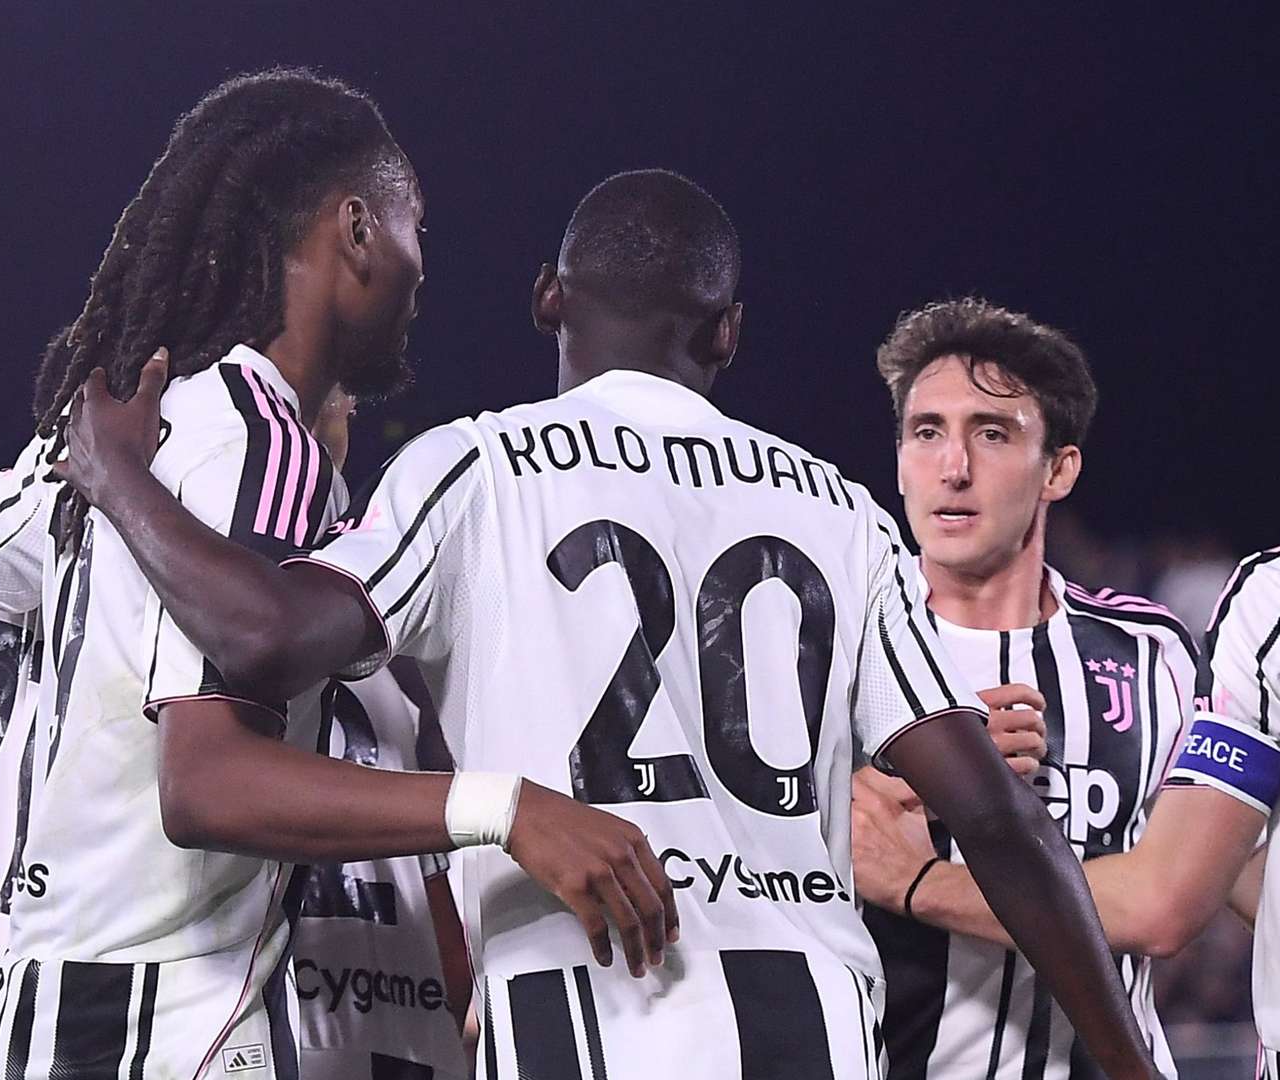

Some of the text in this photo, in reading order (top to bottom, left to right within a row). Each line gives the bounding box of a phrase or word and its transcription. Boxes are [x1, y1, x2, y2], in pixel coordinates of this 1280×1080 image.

[499, 420, 854, 511] KOLO MUANI
[546, 518, 836, 817] 20
[1024, 765, 1119, 842] ep
[295, 958, 454, 1014] Cygame
